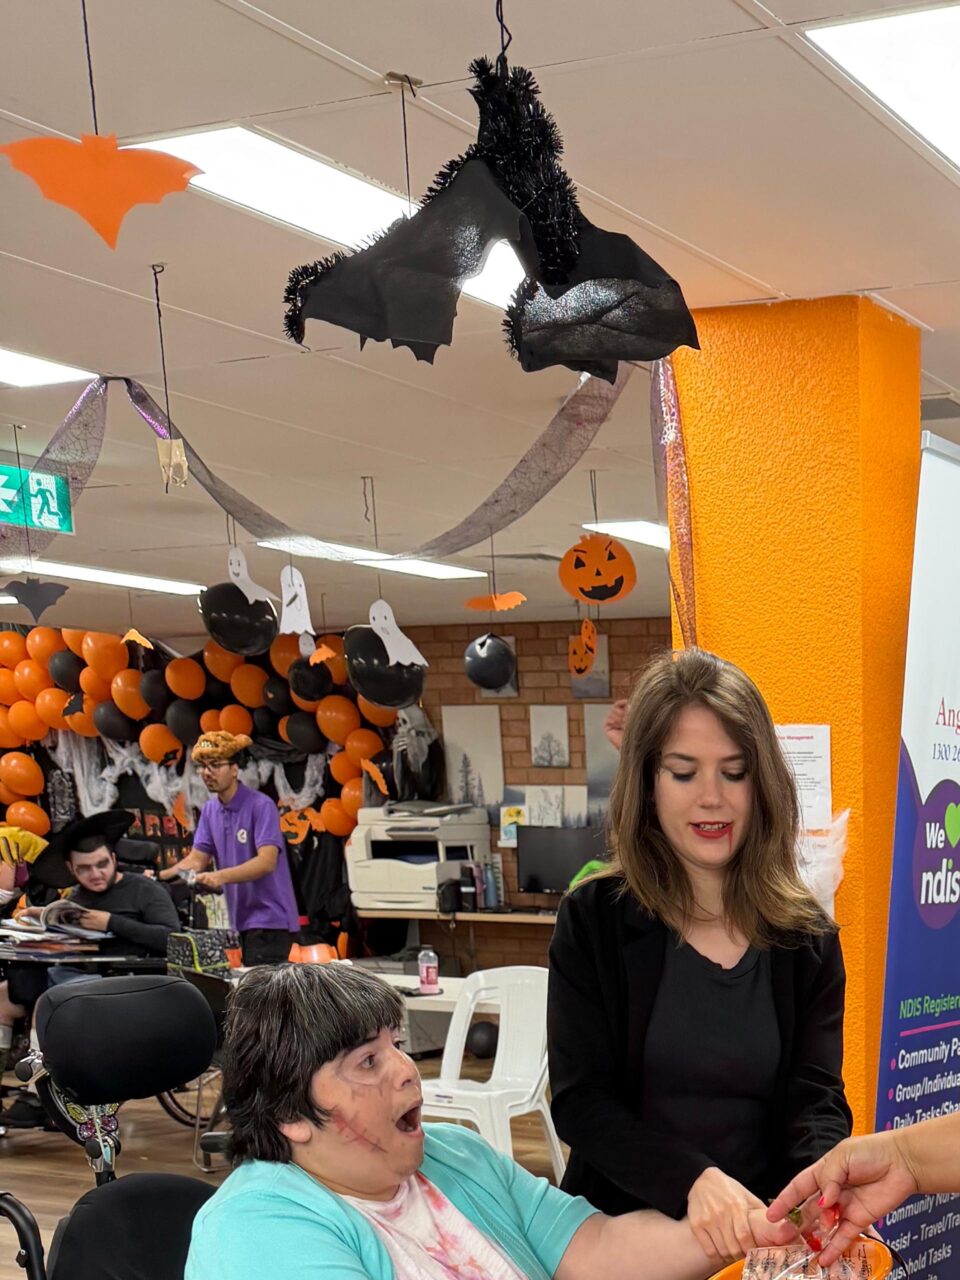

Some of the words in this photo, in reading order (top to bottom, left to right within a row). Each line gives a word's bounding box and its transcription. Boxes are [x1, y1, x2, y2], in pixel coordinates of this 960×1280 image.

[932, 743, 951, 761] 1300
[925, 822, 945, 849] We
[920, 858, 960, 905] ndis
[899, 996, 922, 1019] NDIS
[898, 1040, 950, 1070] Community
[893, 1114, 913, 1130] Daily
[886, 1194, 935, 1226] Community
[928, 1243, 952, 1265] Tasks
